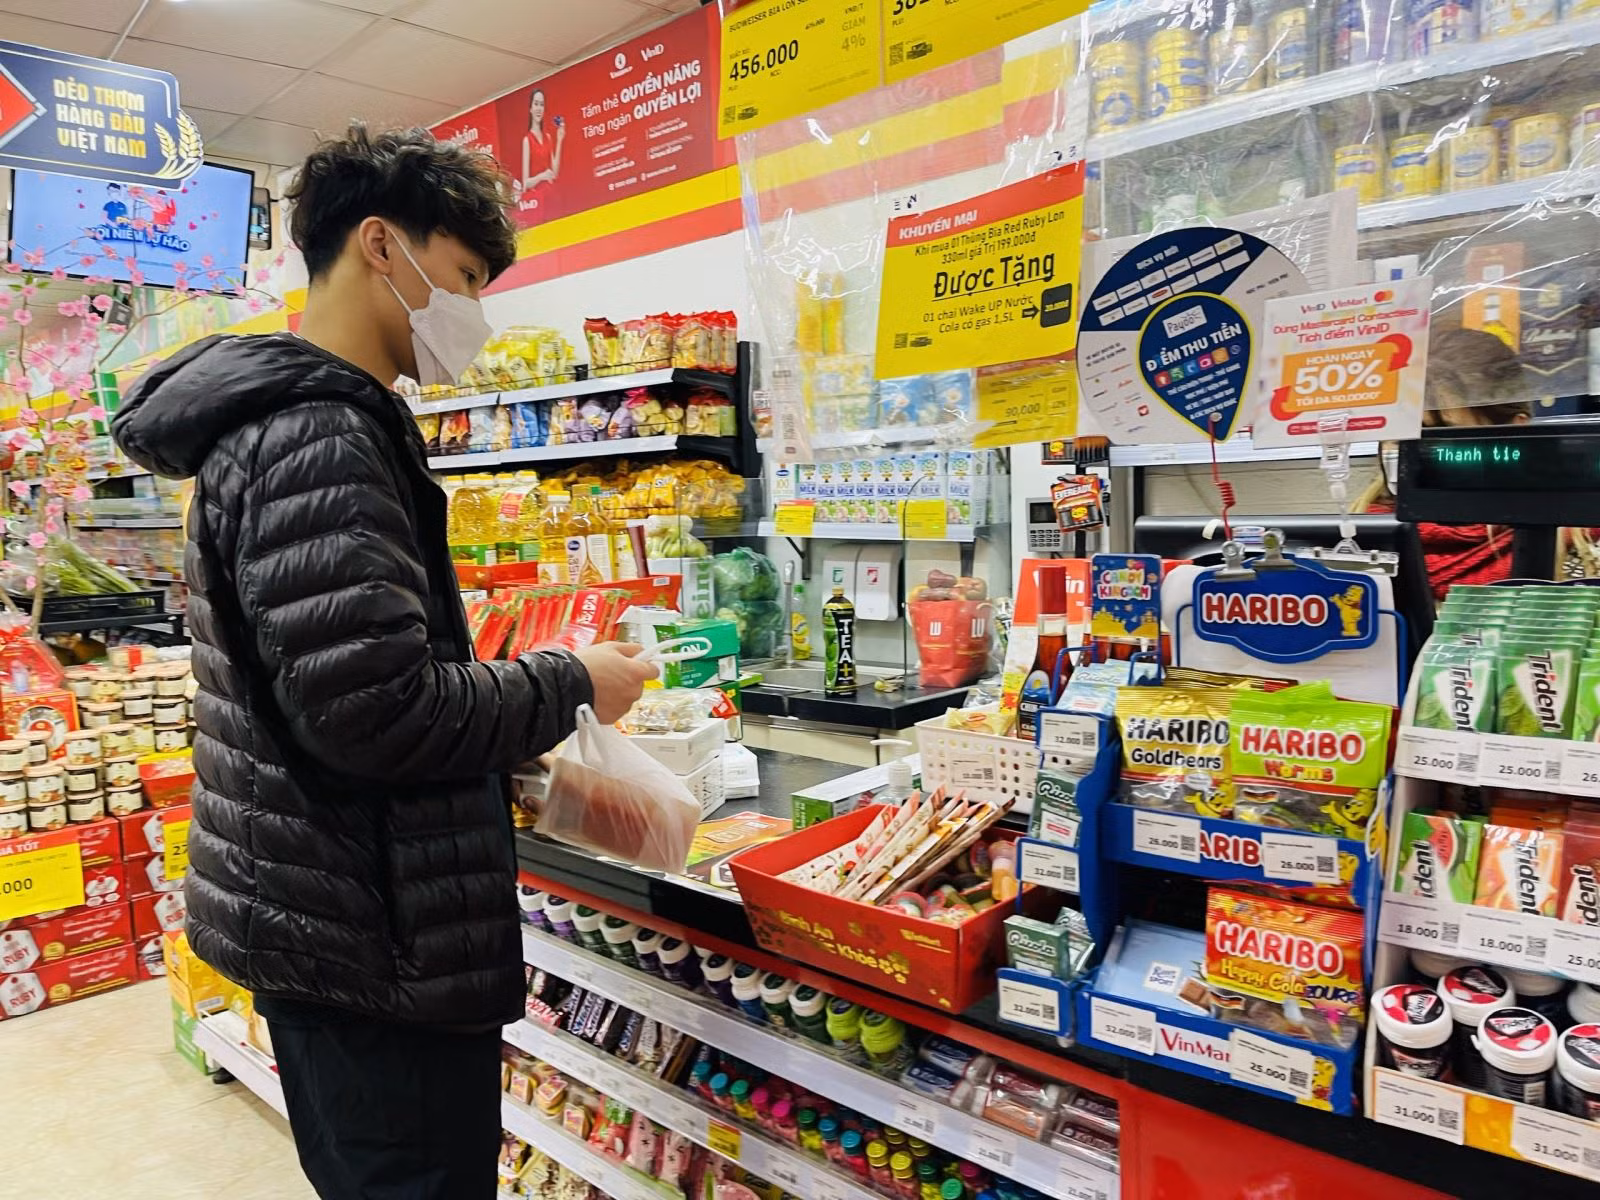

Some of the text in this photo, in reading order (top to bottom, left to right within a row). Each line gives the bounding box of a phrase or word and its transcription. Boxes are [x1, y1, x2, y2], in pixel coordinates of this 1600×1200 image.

[842, 34, 866, 51] 4%
[729, 40, 799, 81] 456.000
[53, 76, 89, 103] DẺO
[581, 59, 702, 119] Tấm thẻ QUYỀN NĂNG
[55, 102, 145, 135] HÀNG ĐẦU
[607, 112, 632, 132] ngàn
[633, 88, 677, 120] QUYỀN
[680, 82, 702, 104] LỢI
[57, 127, 147, 159] VIỆT NAM
[899, 209, 978, 240] KHUYẾN MẠI
[915, 246, 930, 257] Khi
[931, 242, 950, 254] mua
[951, 237, 961, 249] 01
[988, 226, 1003, 240] Bia
[1003, 221, 1021, 235] Red
[1023, 215, 1046, 233] Ruby
[1048, 210, 1065, 223] Lon
[942, 231, 1037, 265] 330ml giá Trị 199.000đ
[934, 252, 1055, 298] Được Tăng
[922, 312, 935, 323] 01
[938, 304, 957, 321] chai
[960, 299, 986, 317] Wake
[988, 296, 1003, 312] UP
[1300, 315, 1356, 331] Mastercard
[1358, 308, 1419, 323] Contactless
[939, 321, 960, 334] Cola
[962, 316, 975, 330] có
[976, 313, 992, 330] gas
[1167, 317, 1195, 335] Payoo
[1357, 322, 1390, 337] VinID
[1146, 346, 1182, 372] ĐỂM
[1181, 336, 1209, 358] THU
[1209, 322, 1243, 345] TIỀN
[1294, 358, 1384, 395] 50%
[1437, 448, 1481, 462] Thanh
[1054, 483, 1094, 500] EVEREADY
[1100, 568, 1145, 588] CANDY
[1097, 584, 1151, 601] KINGDOM
[1203, 594, 1328, 627] HARIBO
[1525, 648, 1564, 732] Trident
[1127, 717, 1230, 745] HARIBO
[1241, 725, 1365, 763] HARIBO
[1131, 747, 1221, 771] Goldbears
[1263, 758, 1333, 782] Worms
[1413, 755, 1454, 770] 25.000
[1498, 764, 1542, 779] 25.000
[16, 840, 41, 857] TỐT
[1200, 829, 1260, 868] ARIB
[1411, 840, 1438, 899] ident
[1569, 865, 1600, 927] ident
[1007, 929, 1057, 959] Ricola
[1397, 924, 1439, 940] 18.000
[1479, 937, 1523, 953] 18.000
[2, 948, 32, 967] RUBY
[1215, 921, 1344, 976] HARIBO
[10, 989, 38, 1009] RUBY
[1105, 1024, 1136, 1040] 52.000
[1160, 1027, 1231, 1065] VinMar
[1248, 1061, 1288, 1083] 25.000
[1394, 1105, 1435, 1124] 31.000
[1534, 1144, 1579, 1163] 31.000
